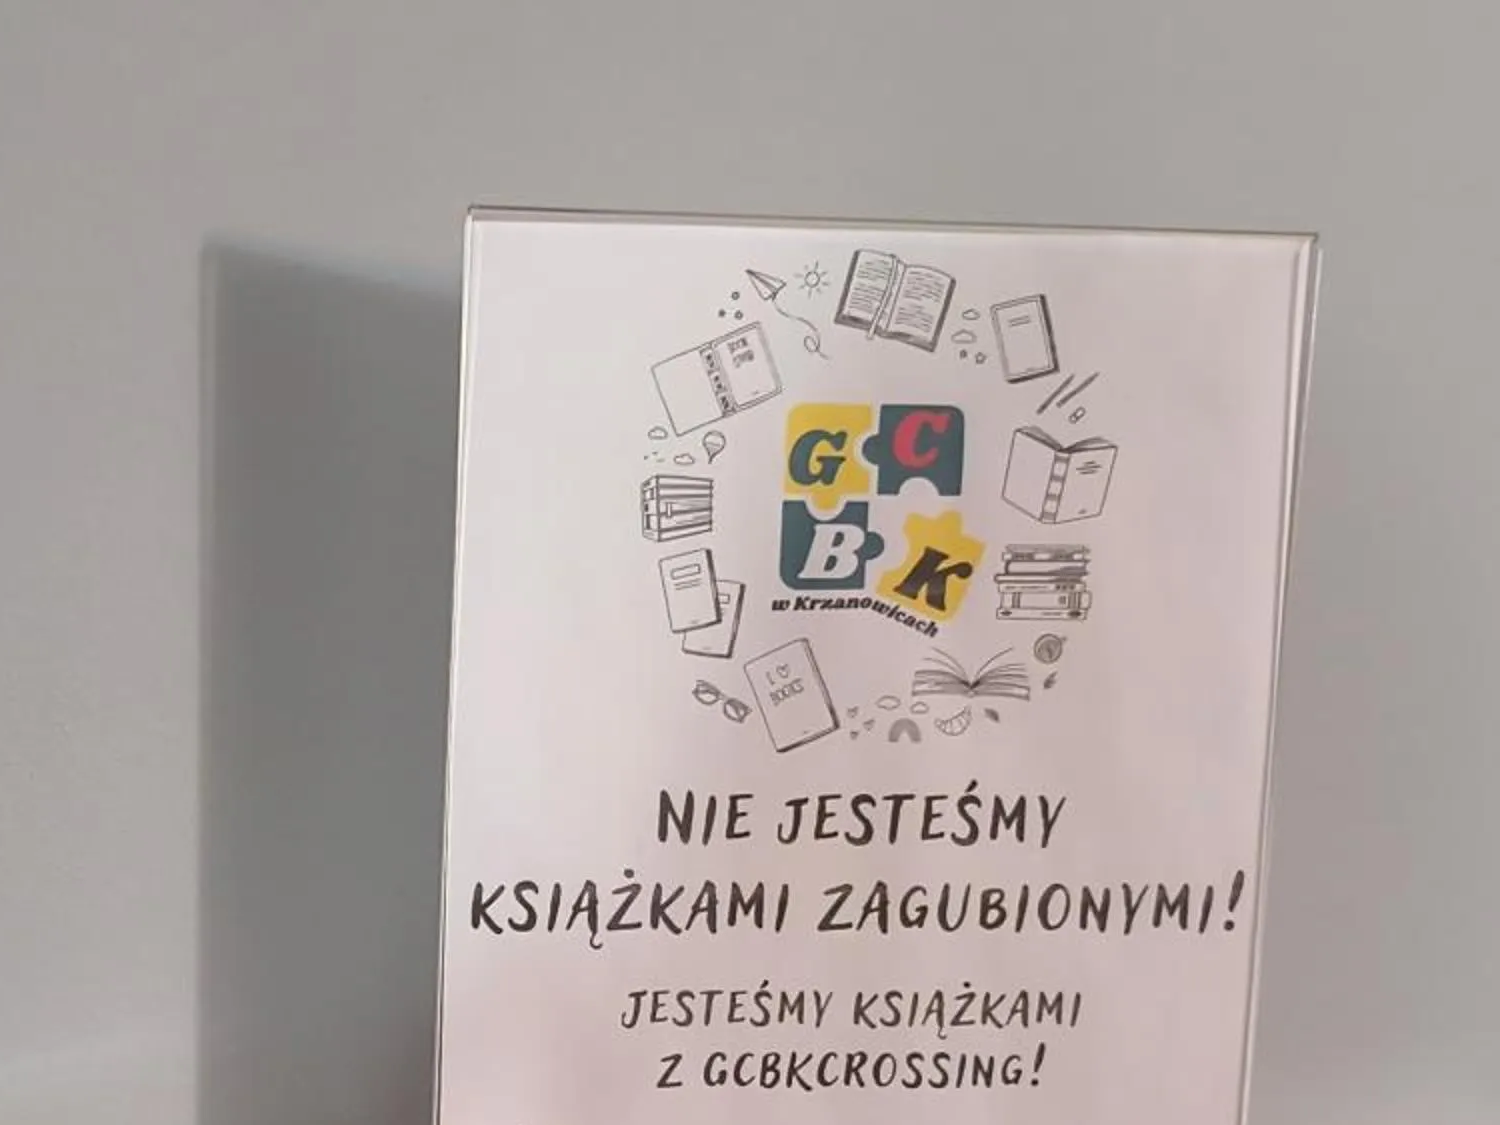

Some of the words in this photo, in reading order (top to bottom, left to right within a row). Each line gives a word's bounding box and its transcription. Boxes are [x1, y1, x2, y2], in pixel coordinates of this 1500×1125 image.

[771, 599, 790, 612] w
[792, 596, 939, 638] Krzanowicach
[657, 789, 755, 847] NIE
[776, 778, 1067, 849] JESTEŚMY
[470, 868, 790, 951] KSIĄŻKAMI
[816, 869, 1244, 935] ZAGUBIONYMI!
[620, 978, 834, 1030] JESTEŚMY
[852, 980, 1082, 1039] KSIĄŻKAMI
[655, 1052, 684, 1089] Z
[703, 1043, 1047, 1093] GCBKCROSSING!
